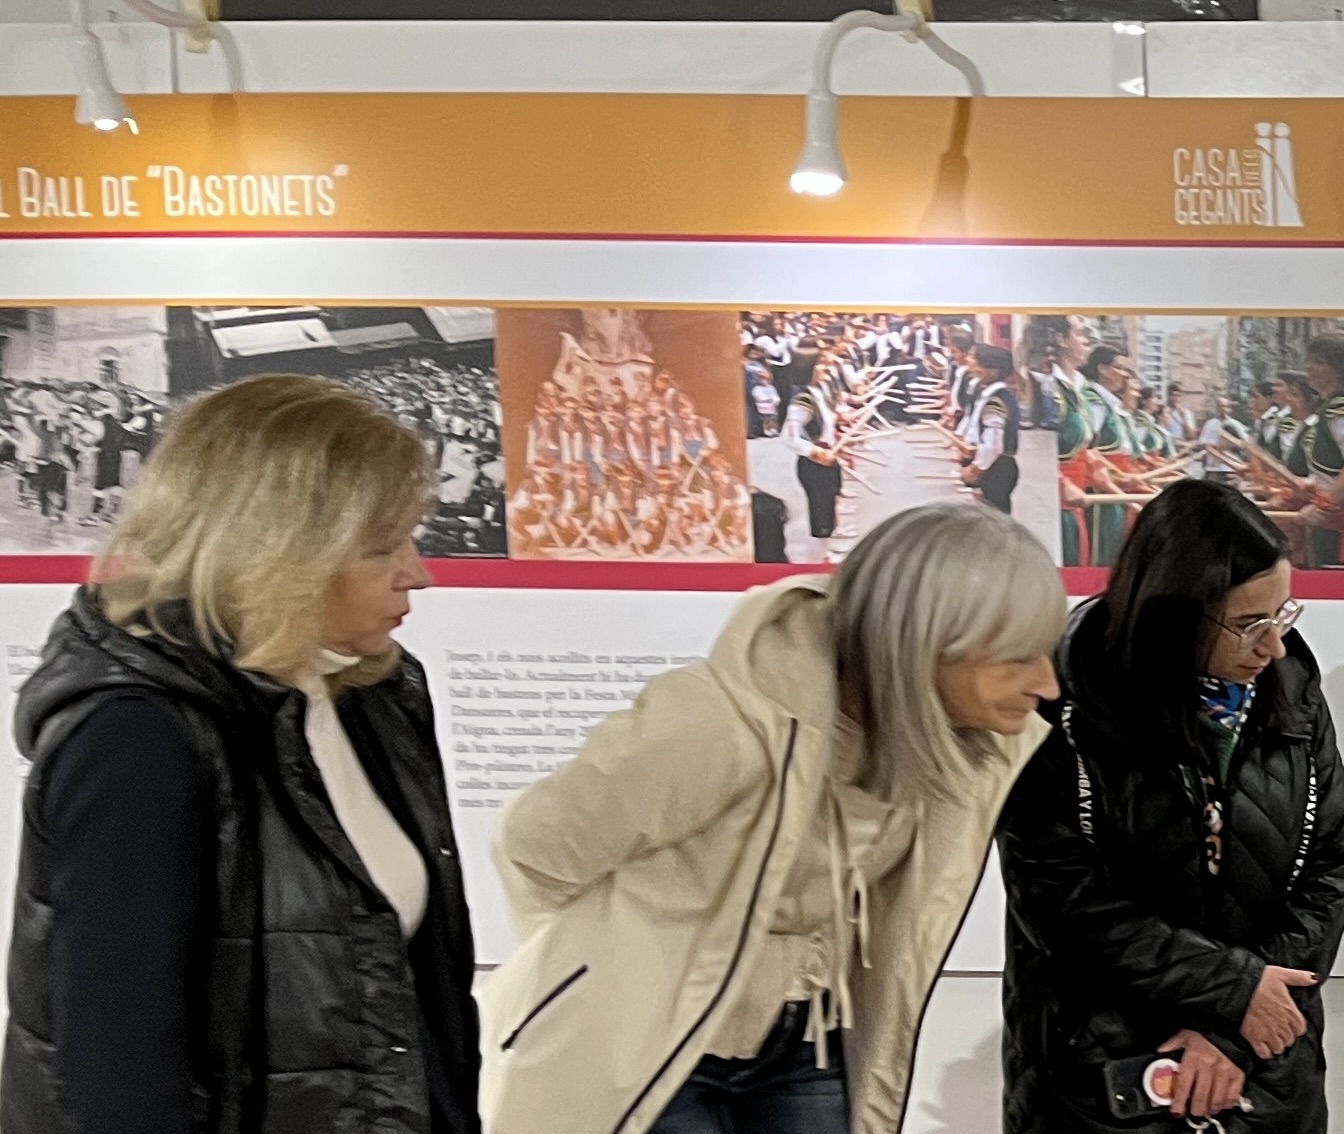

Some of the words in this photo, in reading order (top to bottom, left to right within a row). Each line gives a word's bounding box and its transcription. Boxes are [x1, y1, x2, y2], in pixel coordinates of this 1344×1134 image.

[1173, 147, 1241, 187] CASA
[16, 167, 93, 218] BALL
[101, 175, 140, 217] DE
[1174, 188, 1265, 226] GEGANTS
